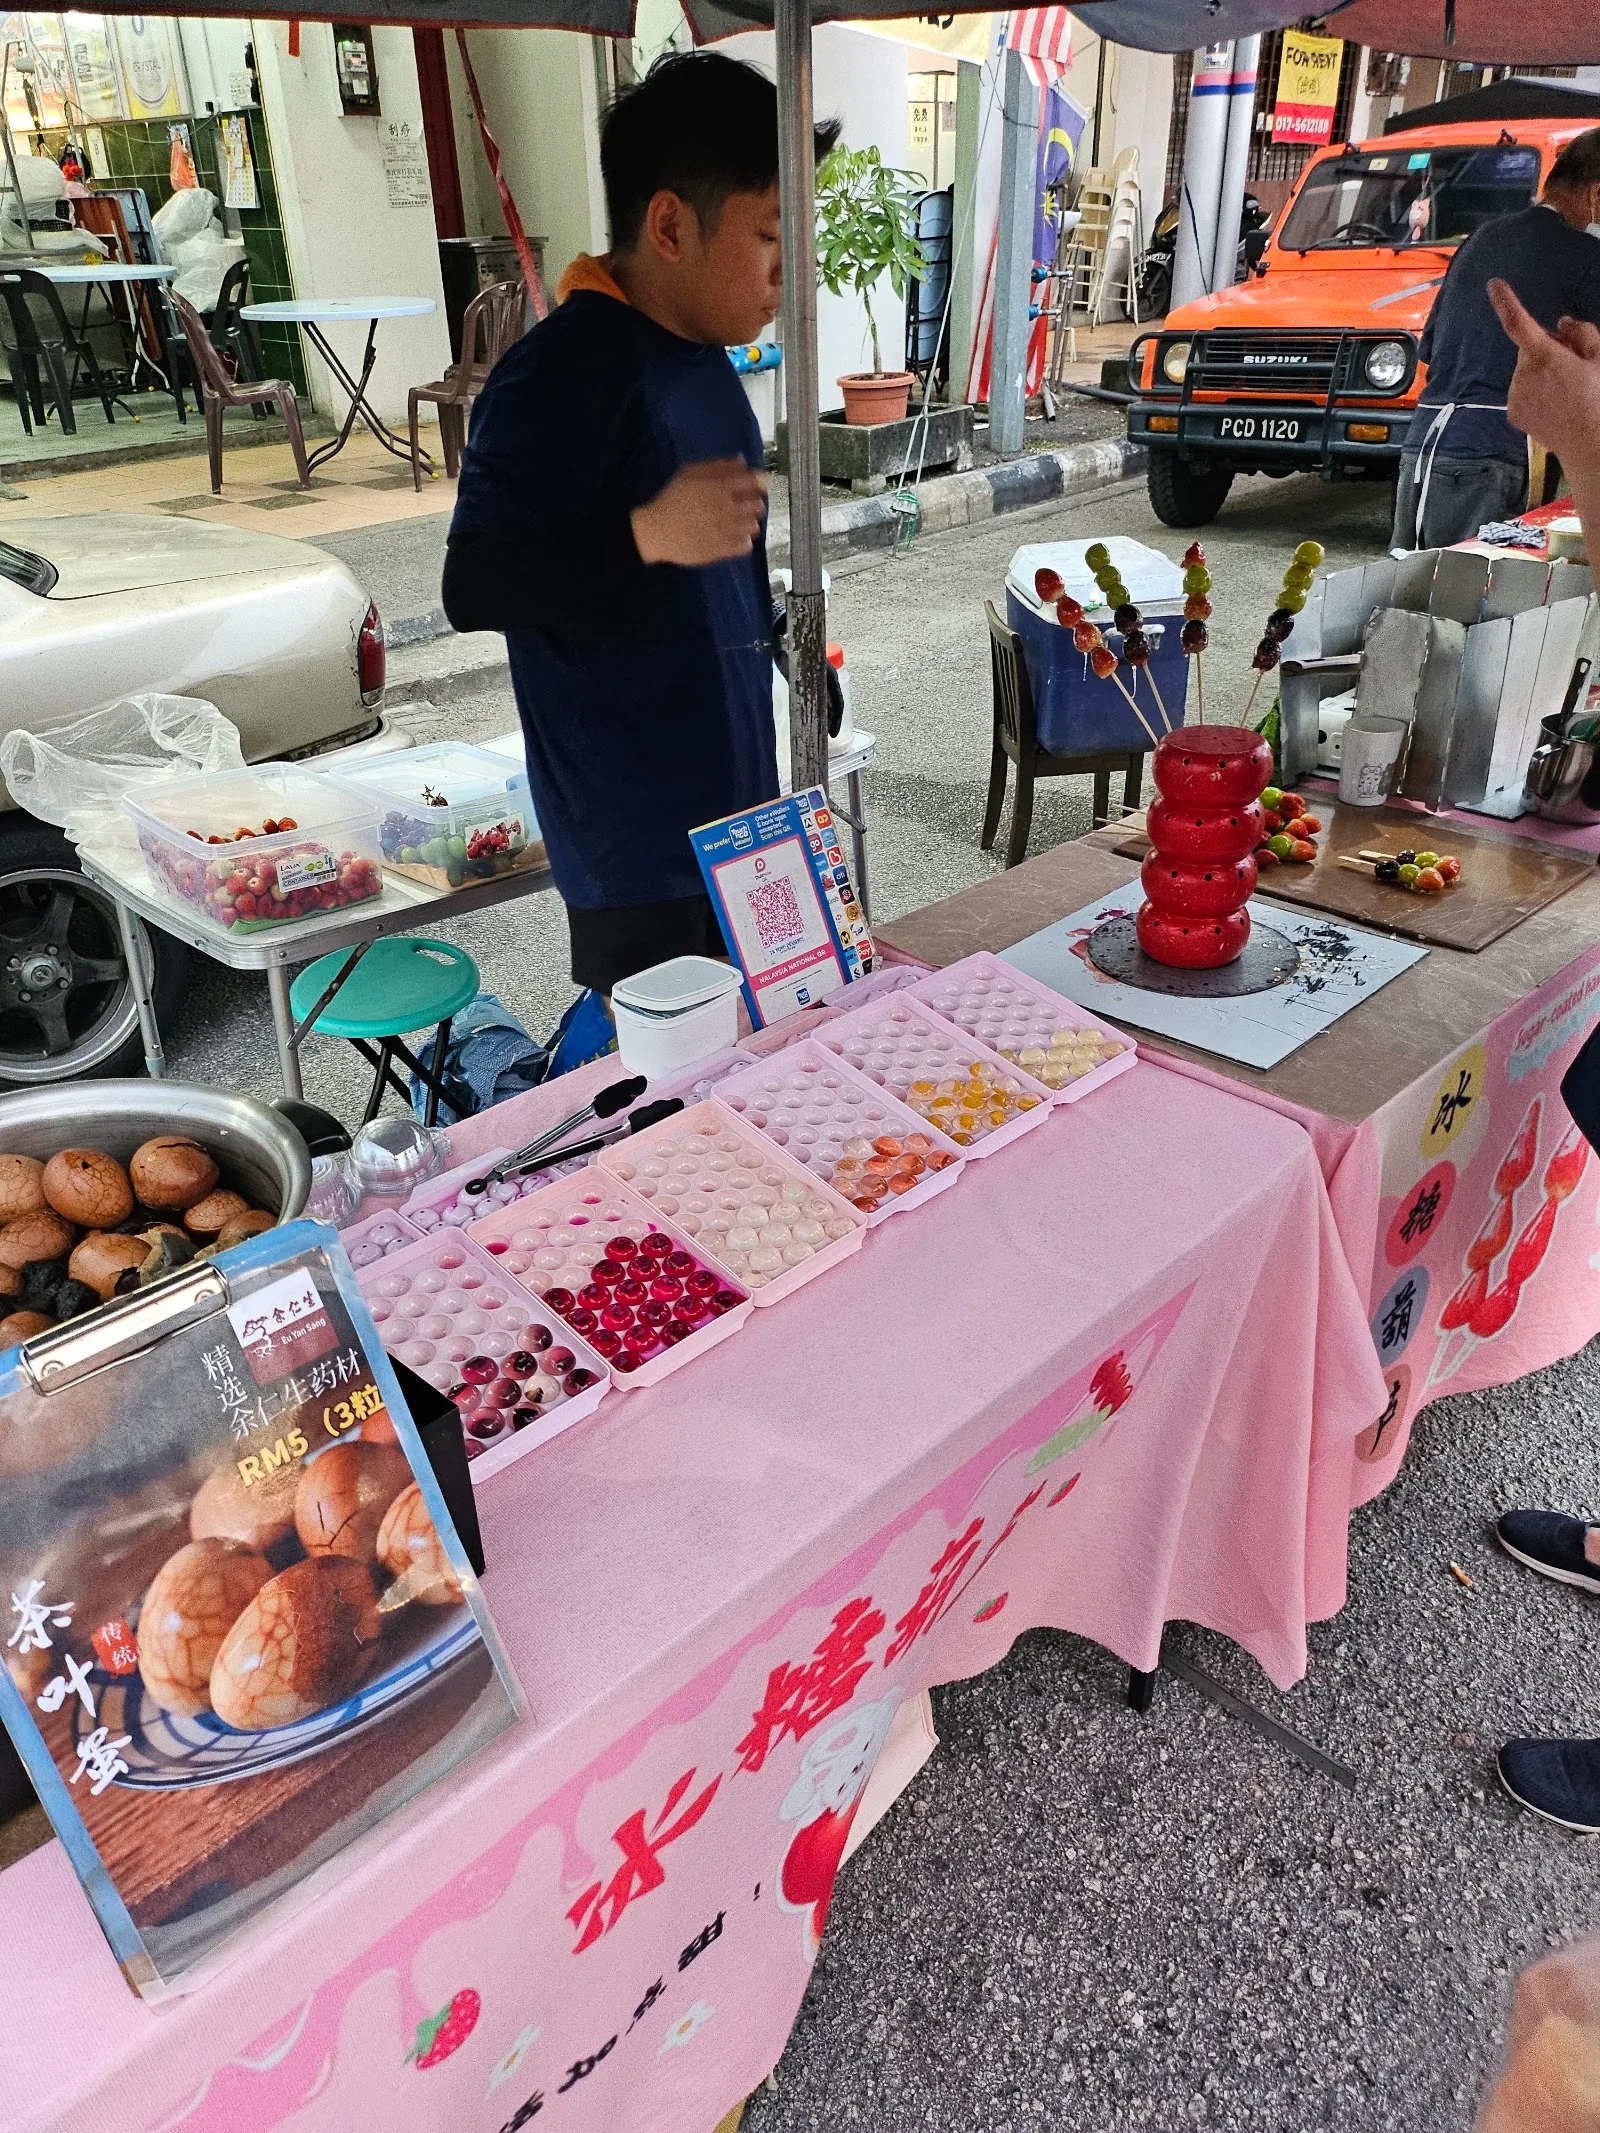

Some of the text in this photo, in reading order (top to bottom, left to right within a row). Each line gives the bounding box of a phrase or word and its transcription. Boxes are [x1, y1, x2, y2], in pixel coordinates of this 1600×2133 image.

[1285, 46, 1338, 70] FOR RENT
[1220, 417, 1299, 439] PCD 1120
[702, 837, 731, 852] We prefer
[760, 832, 774, 841] Scan
[758, 967, 788, 984] MALAYSIA
[788, 954, 817, 971] NATIONAL
[816, 949, 826, 958] QR
[281, 1317, 327, 1345] Eu Yan Sang
[201, 1343, 249, 1413] 精选
[237, 1427, 310, 1488] RM5
[7, 1579, 133, 1796] 茶叶蛋
